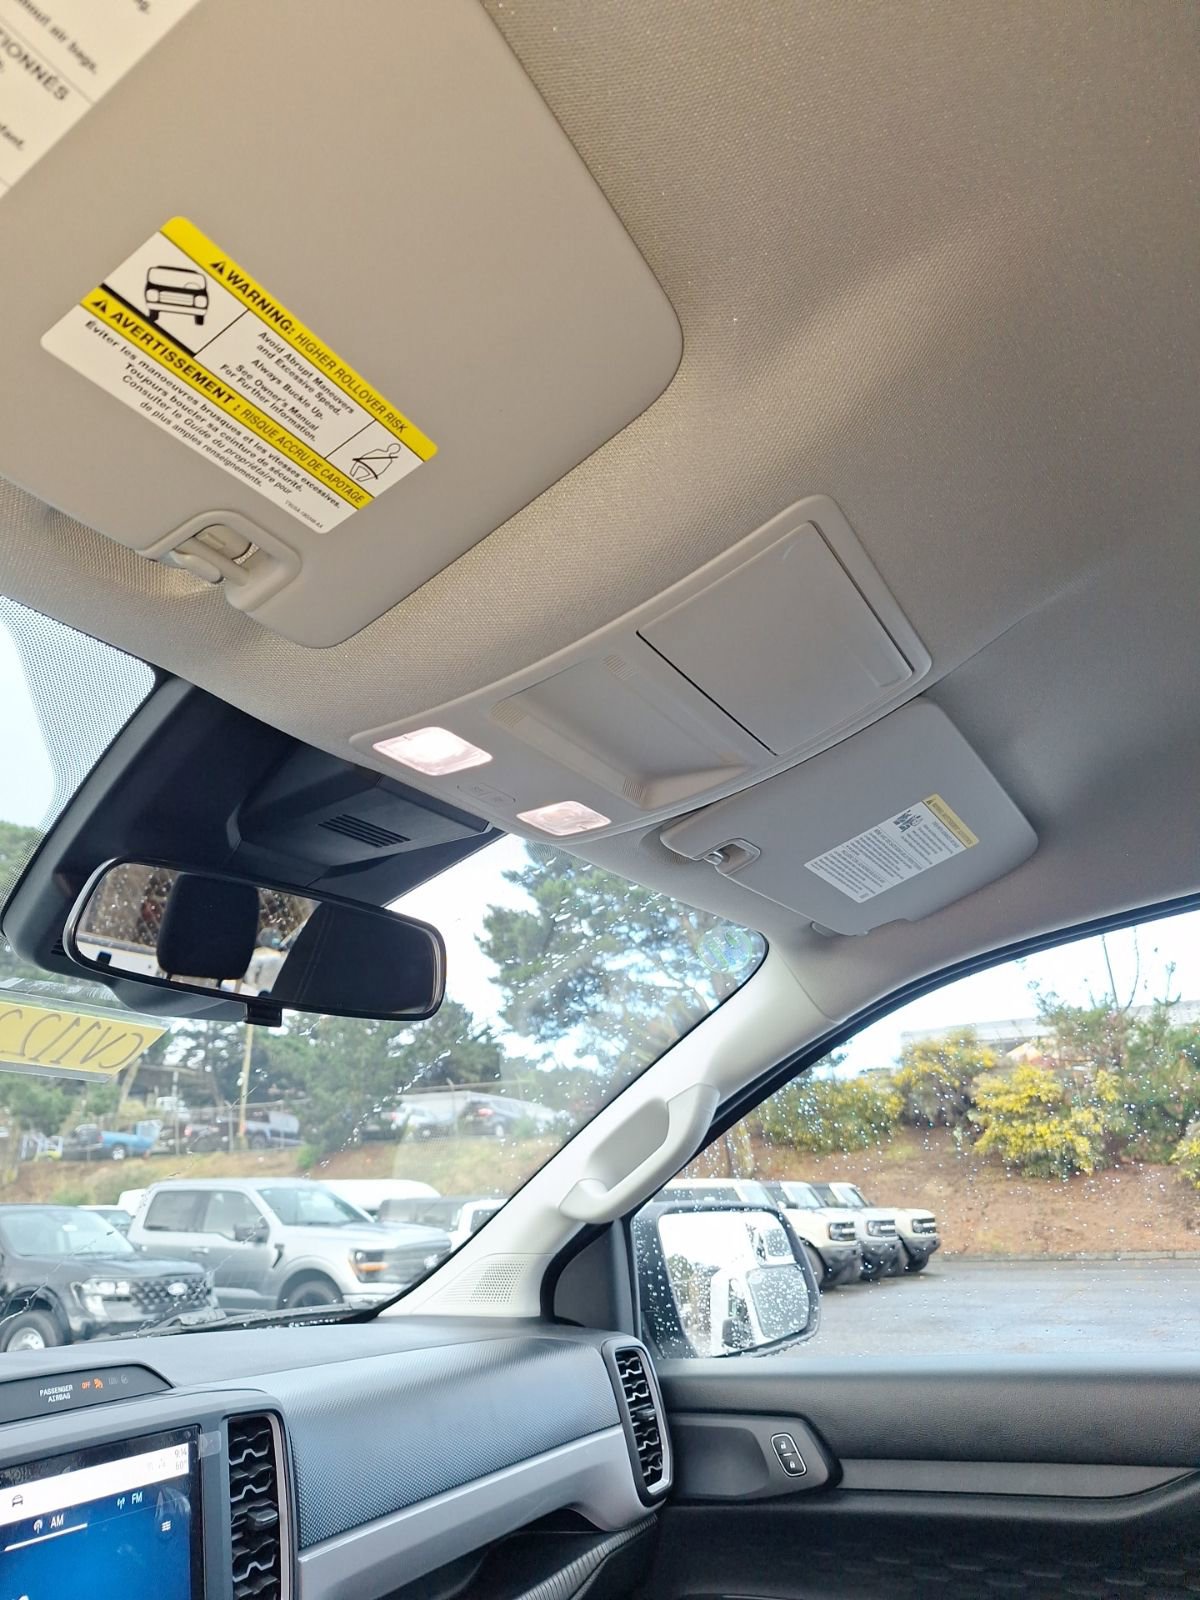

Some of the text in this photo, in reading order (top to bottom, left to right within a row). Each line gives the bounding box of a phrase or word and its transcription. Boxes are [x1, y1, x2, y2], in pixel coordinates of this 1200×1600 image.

[226, 270, 408, 433] WARNING: HIGHER ROLLOVER RISK
[252, 359, 323, 420] Always Buckle Up.
[256, 344, 341, 416] and Excessive Speed.
[258, 331, 354, 414] Avoid Abrupt Maneuvers
[110, 312, 235, 404] AVERTISSEMENT
[240, 408, 279, 438] RISQUE
[275, 436, 310, 462] ACCRU
[307, 458, 323, 471] DE
[320, 468, 365, 504] CAPOTAGE
[120, 345, 137, 361] les
[138, 360, 199, 406] manoeuvres
[199, 403, 242, 437] brusques
[242, 435, 254, 444] et
[253, 442, 267, 454] les
[268, 453, 300, 478] vitesses
[301, 477, 340, 509] excessives.
[122, 375, 293, 495] Consulter le Guide du propriétaire pour
[125, 362, 168, 397] Toujours
[170, 395, 208, 424] boucler
[207, 422, 219, 433] sa
[219, 431, 257, 458] ceinture
[256, 457, 269, 467] de
[220, 364, 317, 442] For Further Information.
[235, 364, 319, 431] See Owner's Manual
[140, 401, 262, 487] de plus amples renseignements.
[39, 1384, 73, 1397] PASSENGER
[47, 1392, 71, 1403] AIRBAG
[50, 1514, 64, 1529] AM
[131, 1492, 143, 1505] FM
